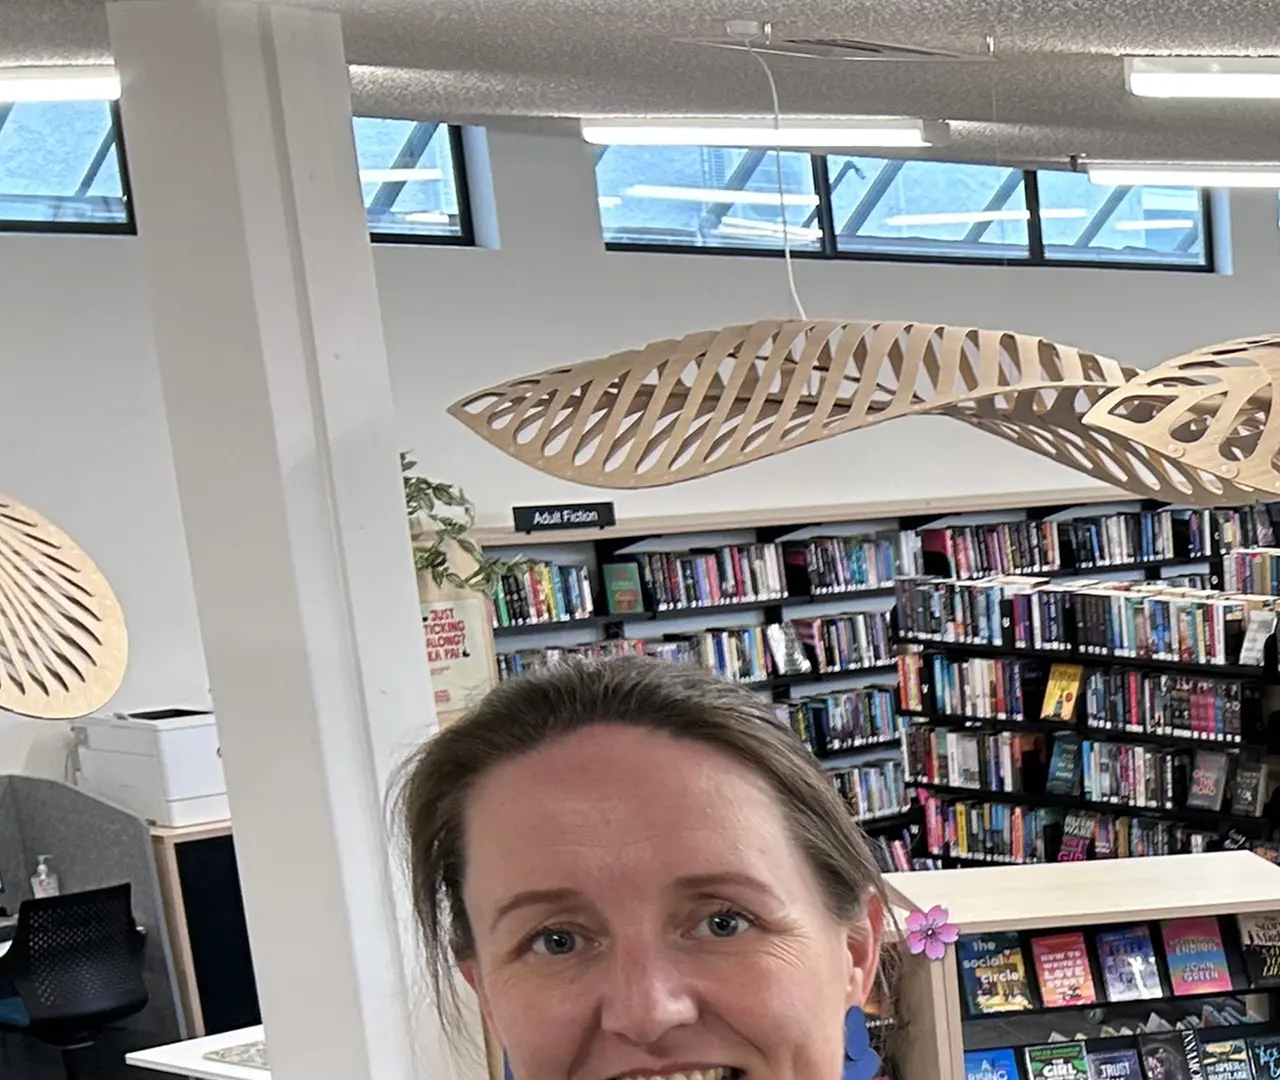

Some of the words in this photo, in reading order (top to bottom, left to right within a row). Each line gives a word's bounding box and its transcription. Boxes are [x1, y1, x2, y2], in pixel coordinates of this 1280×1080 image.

[533, 511, 561, 525] Adult
[563, 509, 598, 523] Fiction
[963, 954, 1004, 969] social
[980, 968, 1019, 983] circle
[1044, 967, 1085, 980] LOVE
[1183, 970, 1219, 982] GREEN
[1042, 1063, 1077, 1077] GIRL
